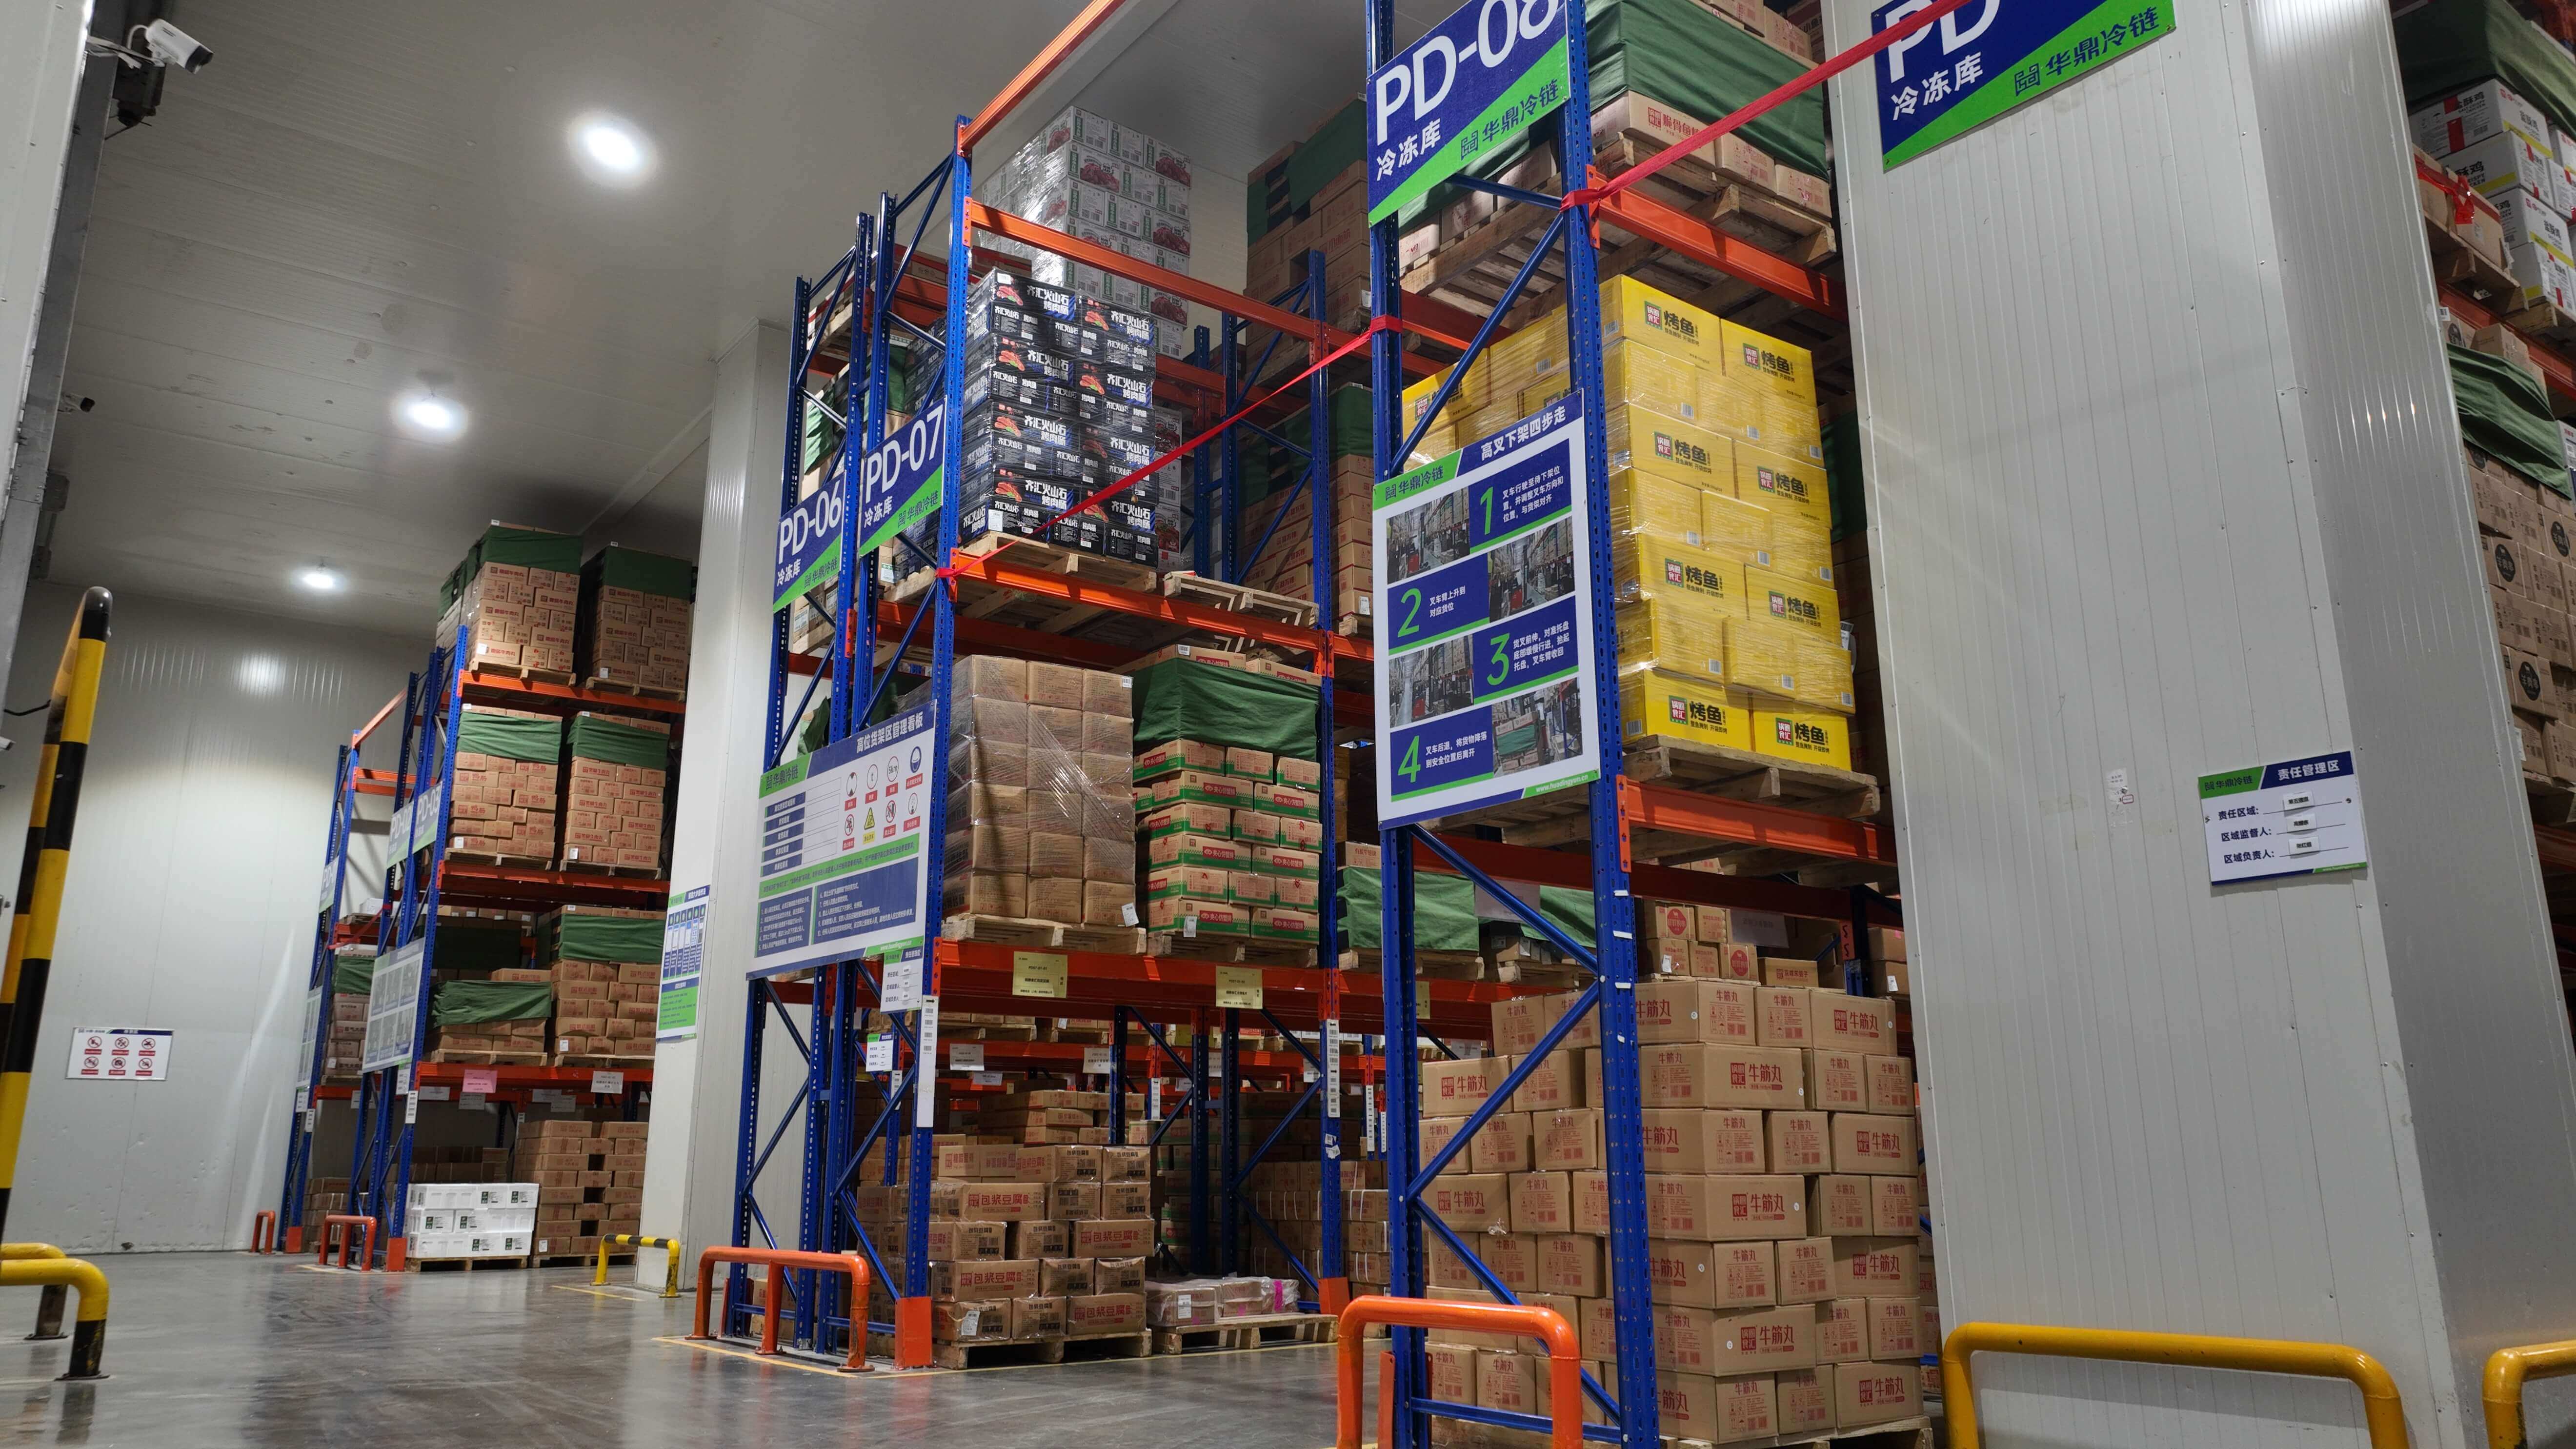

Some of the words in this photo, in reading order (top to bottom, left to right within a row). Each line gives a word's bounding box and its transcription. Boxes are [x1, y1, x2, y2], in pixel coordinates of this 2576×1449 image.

[2046, 7, 2159, 76] 华鼎冷链
[1891, 51, 1983, 120] 冷冻库
[1482, 79, 1558, 142] 华鼎冷链
[1376, 118, 1441, 181] 冷冻库
[1664, 310, 1694, 337] 烤鱼
[1761, 350, 1790, 375] 烤鱼
[1024, 415, 1066, 434] 齐汇火山石
[1481, 406, 1566, 462] 高叉下架四步走
[1041, 431, 1066, 446] 烤肉肠
[865, 404, 943, 503] PD-07
[1674, 439, 1707, 466] 烤鱼
[1398, 465, 1444, 495] 华鼎冷链
[1775, 473, 1804, 496] 烤鱼
[1025, 480, 1067, 500] 齐汇火山石
[864, 496, 893, 528] 冷冻库
[1042, 495, 1067, 511] 烤肉肠
[1111, 501, 1151, 520] 齐汇火山石
[1480, 486, 1493, 535] 1
[779, 480, 842, 564] PD-06
[1127, 515, 1150, 530] 烤肉肠
[777, 559, 801, 586] 冷冻库
[1686, 564, 1719, 591] 烤鱼
[1398, 588, 1422, 637] 2
[1429, 601, 1454, 617] 对应货位
[1788, 596, 1817, 620] 烤鱼
[1487, 633, 1510, 685] 3
[1689, 701, 1723, 725] 烤鱼
[857, 711, 924, 754] 高位货架区管理看板
[1795, 723, 1825, 745] 烤鱼
[1398, 736, 1421, 783] 4
[2278, 760, 2340, 780] 责任管理区
[1716, 990, 1738, 1003] 牛筋丸
[1773, 995, 1794, 1007] 牛筋丸
[1507, 1006, 1527, 1015] 牛筋丸
[1635, 999, 1671, 1019] 牛筋丸
[1850, 1012, 1879, 1032] 牛筋丸
[1659, 1052, 1682, 1064] 牛筋丸
[1830, 1057, 1850, 1070] 牛筋丸
[1456, 1075, 1487, 1091] 牛筋丸
[1749, 1064, 1782, 1083] 牛筋丸
[1429, 1125, 1449, 1135] 牛筋丸
[1723, 1117, 1746, 1129] 牛筋丸
[1790, 1119, 1811, 1131] 牛筋丸
[1642, 1127, 1679, 1146] 牛筋丸
[1872, 1132, 1901, 1151] 牛筋丸
[1527, 1179, 1549, 1190] 牛筋丸
[982, 1193, 1023, 1207] 包浆豆腐
[1453, 1191, 1485, 1208] 牛筋丸
[1750, 1193, 1785, 1212] 牛筋丸
[1093, 1230, 1133, 1242] 包浆豆腐
[1733, 1249, 1756, 1262] 牛筋丸
[1796, 1246, 1817, 1258] 牛筋丸
[1650, 1258, 1686, 1279] 牛筋丸
[1869, 1254, 1900, 1272] 牛筋丸
[974, 1272, 1015, 1284] 包浆豆腐
[1087, 1304, 1125, 1317] 包浆豆腐
[1829, 1308, 1850, 1319] 牛筋丸
[1886, 1305, 1906, 1316] 牛筋丸
[1759, 1325, 1794, 1345] 牛筋丸
[1735, 1381, 1759, 1395] 牛筋丸
[1874, 1376, 1905, 1397] 牛筋丸
